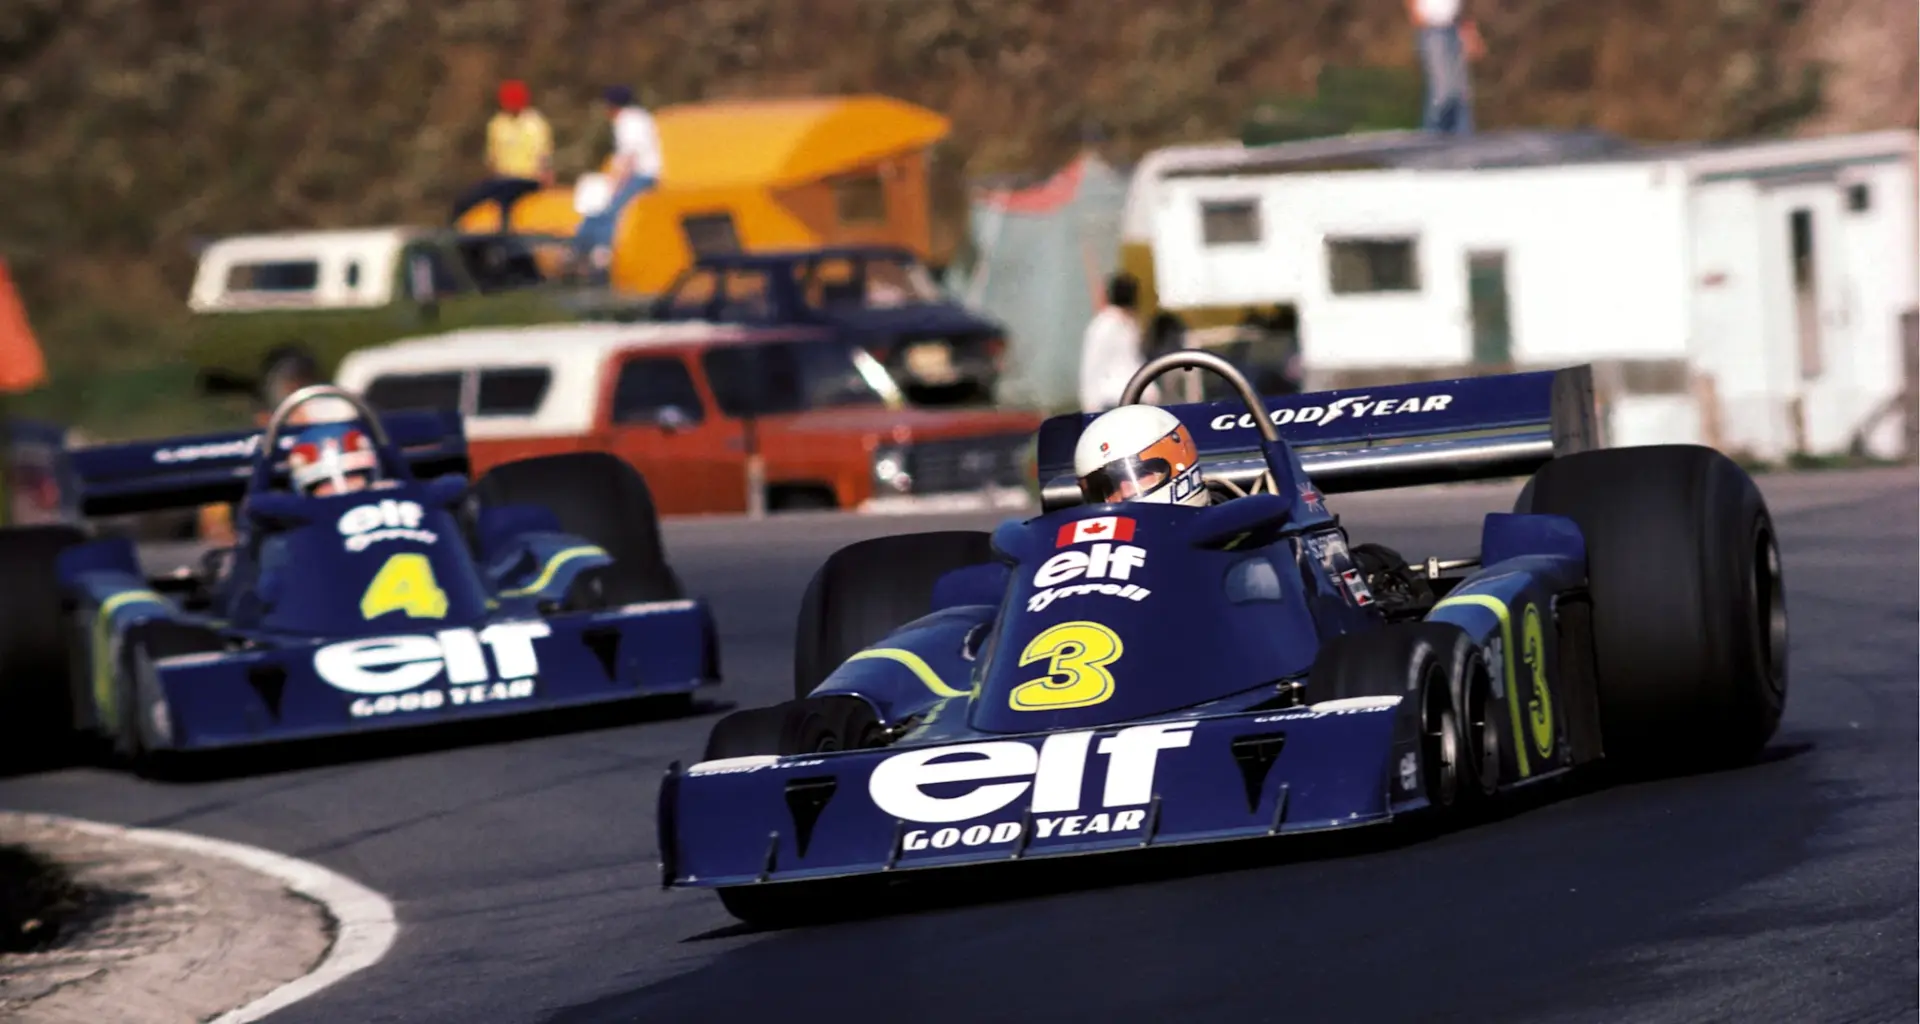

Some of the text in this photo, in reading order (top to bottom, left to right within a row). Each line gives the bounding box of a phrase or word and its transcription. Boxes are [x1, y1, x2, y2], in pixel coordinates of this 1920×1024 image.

[1352, 395, 1453, 418] YEAR
[360, 552, 449, 620] 4
[1033, 543, 1147, 588] elf
[313, 620, 551, 694] elf
[1008, 620, 1124, 712] 3
[1522, 602, 1553, 758] 3
[350, 678, 534, 717] GOOD YEAR
[868, 720, 1200, 823] elf
[903, 810, 1147, 851] GOOD YEAR
